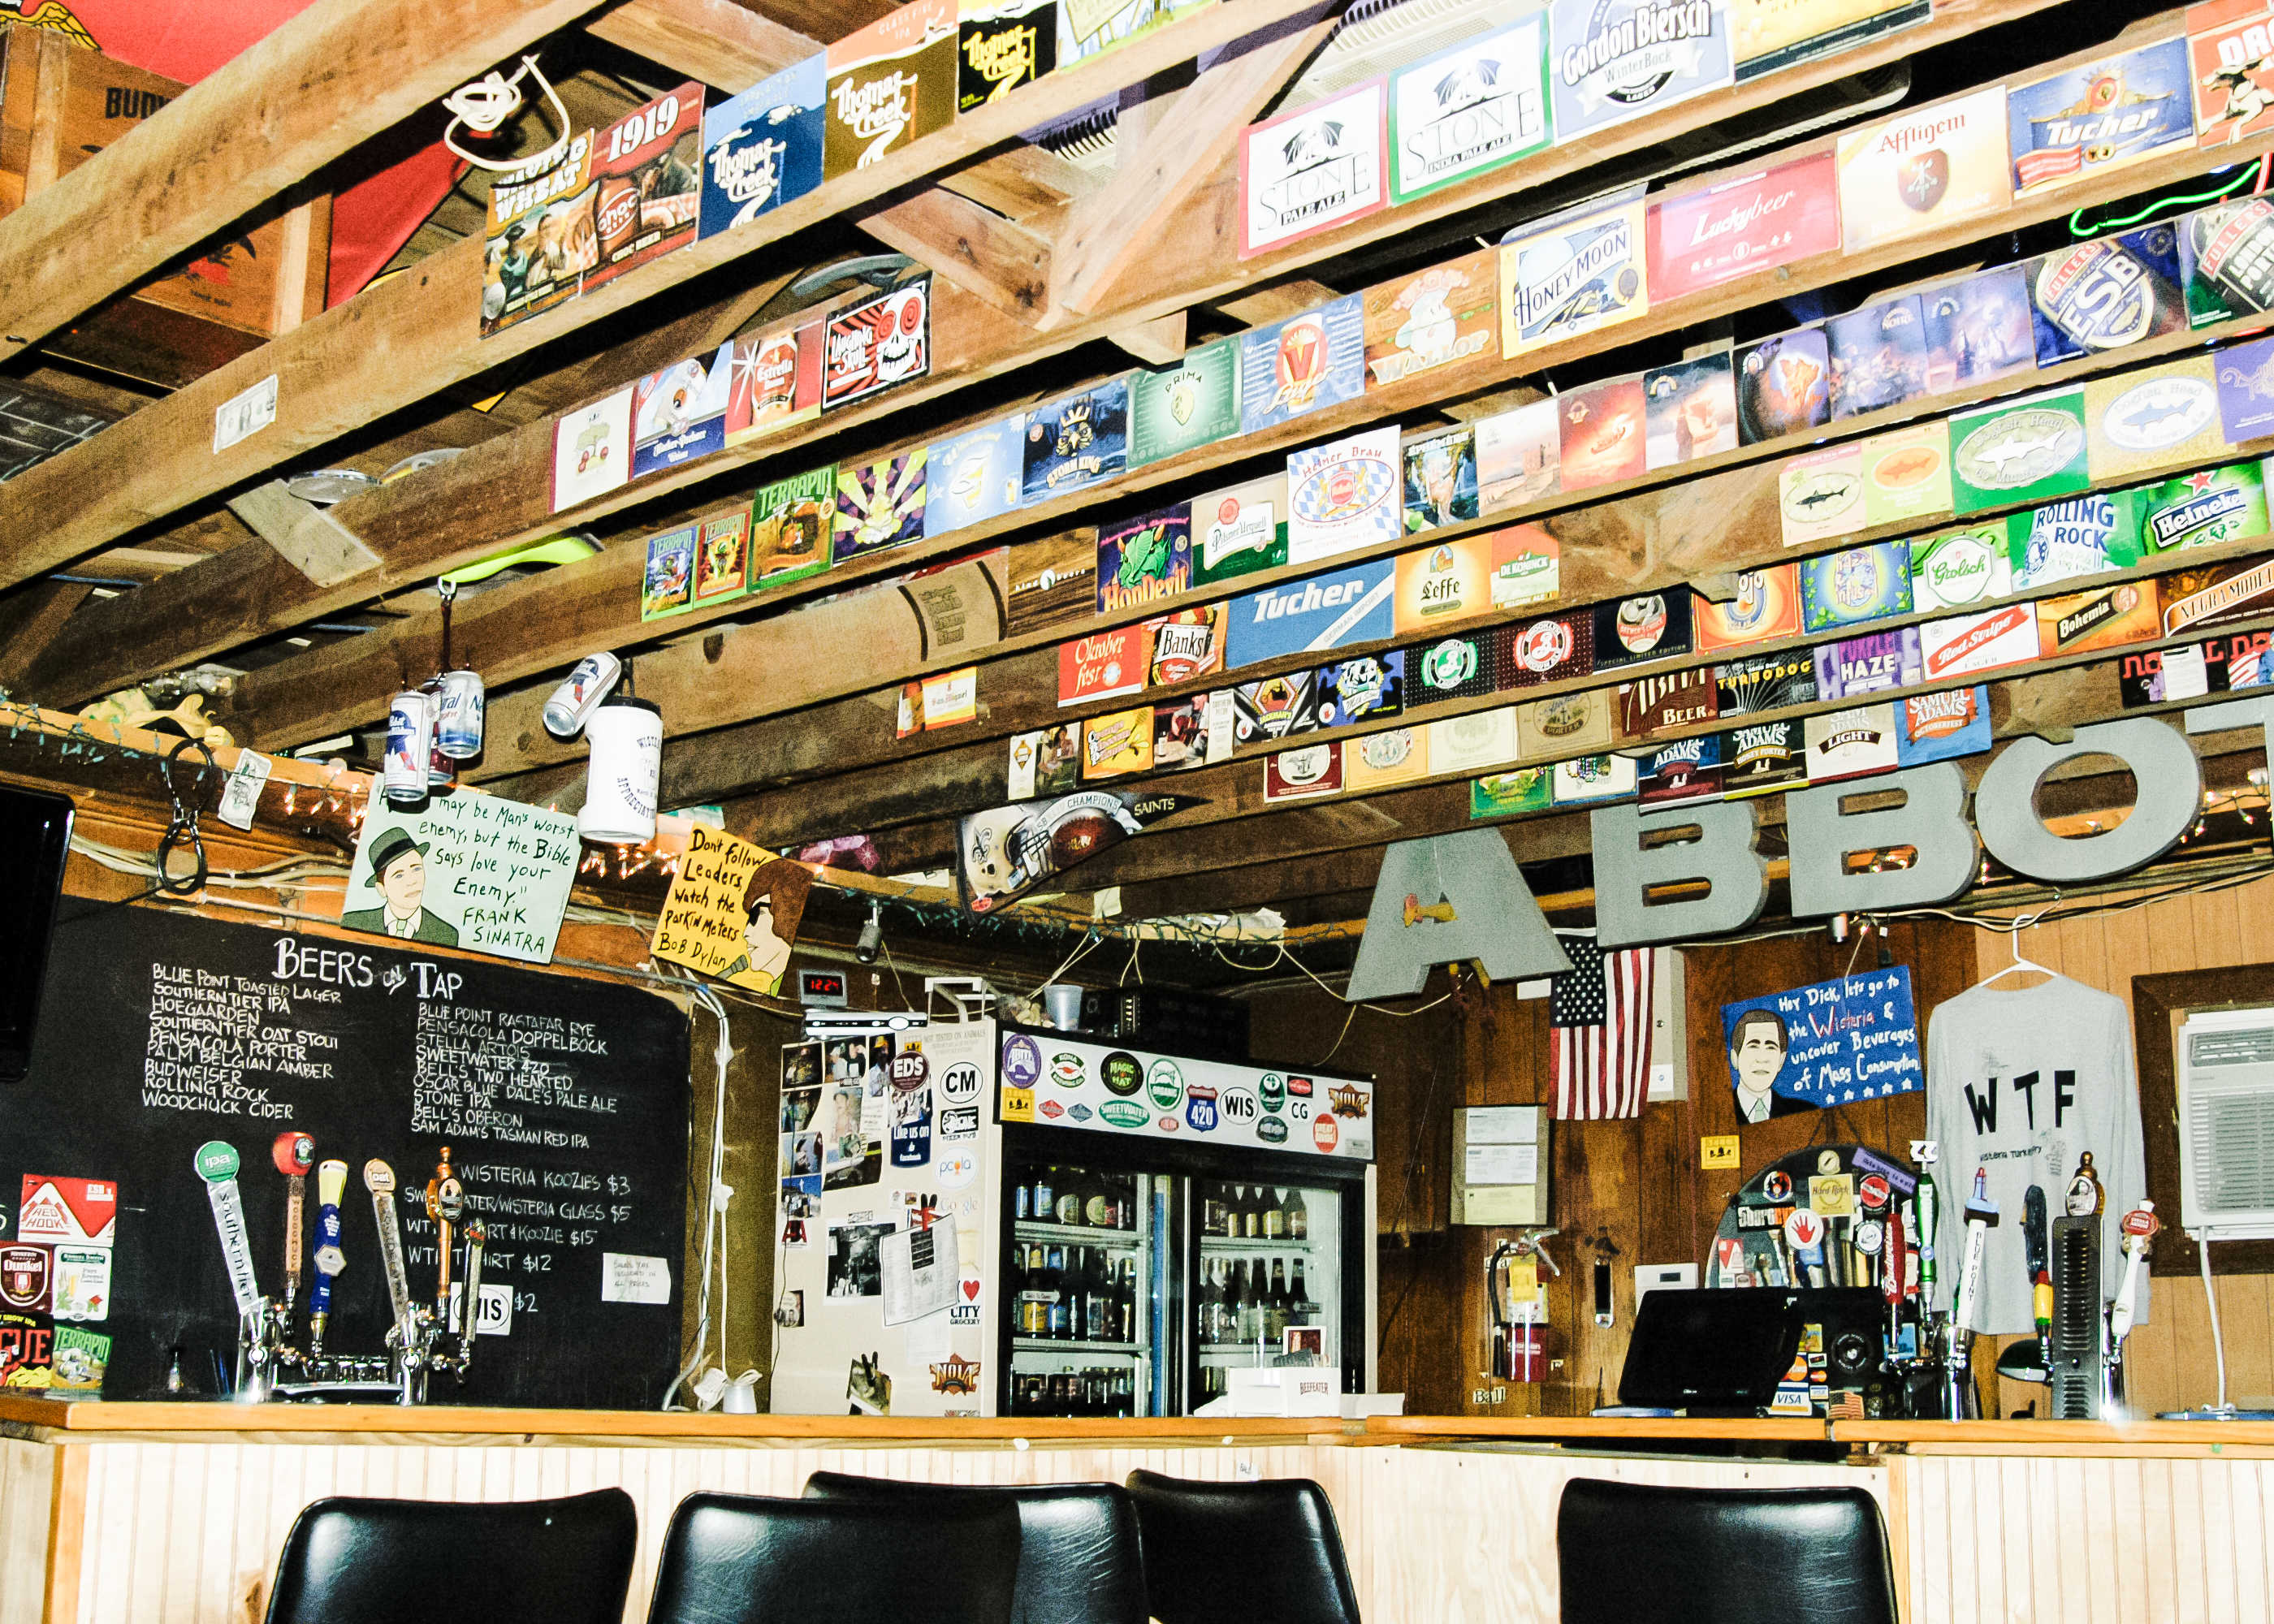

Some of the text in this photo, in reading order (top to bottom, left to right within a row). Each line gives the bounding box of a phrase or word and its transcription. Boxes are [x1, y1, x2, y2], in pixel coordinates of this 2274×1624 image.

[1561, 19, 1636, 86] Gordon
[607, 95, 680, 162] 1919
[1406, 89, 1540, 181] STONE
[1878, 113, 1965, 154] Affligem
[2046, 106, 2159, 147] Tucher
[1258, 152, 1371, 231] STONE
[1514, 266, 1574, 326] HONEY
[1576, 230, 1628, 279] MOON
[2060, 253, 2142, 339] ESB
[834, 347, 870, 374] SKULL
[1165, 370, 1203, 393] PRIMA
[759, 468, 832, 519] TERRAPIN
[2036, 499, 2114, 529] ROLLING
[2055, 526, 2108, 553] ROCK
[1932, 555, 1985, 585] Grolsch
[1252, 579, 1364, 624] Tucher
[1420, 577, 1461, 601] Leffe
[2060, 603, 2110, 638] Bohemia
[1161, 630, 1204, 659] Banks
[1719, 660, 1812, 689] TURBODOG
[1840, 654, 1896, 681] HAZE
[1663, 705, 1706, 725] BEER
[1915, 703, 1966, 728] ADAMS
[1737, 735, 1786, 756] ADAMS
[1828, 732, 1873, 749] LIGHT
[1654, 745, 1701, 768] ADAMS
[439, 797, 575, 839] may be Man's worst
[1135, 797, 1175, 816] SAINTS
[419, 821, 571, 866] enemy, but the Bible
[689, 828, 723, 853] Don't
[470, 851, 497, 873] love
[508, 864, 551, 882] your
[462, 907, 527, 926] FRANK
[716, 892, 735, 914] the
[473, 926, 546, 954] SINATRA
[690, 941, 727, 968] Dylan
[270, 937, 374, 988] BEERS
[410, 961, 463, 1000] TAP
[152, 963, 192, 984] BLUE
[234, 977, 290, 998] TOASTED
[293, 983, 342, 1004] LAGER
[153, 981, 291, 1015] SOUTHERN TIER IPA
[1805, 986, 1841, 1007] Dick,
[1844, 978, 1865, 999] lets
[1868, 981, 1883, 998] go
[1886, 974, 1900, 990] to
[151, 996, 260, 1026] HOEGAARDEN
[418, 1001, 451, 1021] BLUE
[455, 1007, 492, 1024] POINT
[569, 1021, 597, 1039] RYE
[149, 1011, 338, 1050] SOUTHERN TIER OAT STOUT
[149, 1026, 307, 1061] PENSACOLA PORTER
[417, 1017, 506, 1042] PENSACOLA
[1788, 1021, 1808, 1042] the
[147, 1040, 335, 1079] PALM BELGIAN AMBER
[415, 1031, 531, 1061] STELLA ARTOIS
[415, 1044, 550, 1075] SWEETWATER 420
[1790, 1026, 1916, 1065] uncover Beverages
[145, 1057, 243, 1086] BUDWEISER
[416, 1061, 573, 1092] BELL'S TWO HEARTED
[893, 1058, 923, 1078] EDS
[945, 1070, 976, 1094] CM
[1792, 1067, 1813, 1092] of
[1818, 1065, 1852, 1091] Mass
[145, 1072, 270, 1104] ROLLING ROCK
[413, 1073, 618, 1113] OSCAR BLUE DALE'S PALE ALE
[413, 1088, 492, 1109] STONE IPA
[1963, 1069, 2076, 1136] WTF
[141, 1088, 294, 1120] WOODCHUCK CIDER
[413, 1104, 523, 1127] BELL'S OBERON
[1191, 1106, 1213, 1125] 420
[1225, 1095, 1254, 1116] WIS
[1291, 1102, 1308, 1120] CG
[411, 1117, 590, 1149] SAM ADAM'S TASMAN RED IPA
[204, 1154, 231, 1168] ipa
[460, 1164, 631, 1196] WISTERIA KOOZIES $3
[25, 1218, 63, 1229] HOOK
[559, 1203, 633, 1224] GLASS $5
[518, 1227, 564, 1245] KOOZIE
[570, 1229, 598, 1246] $15
[523, 1254, 553, 1273] $12
[514, 1292, 538, 1312] $2
[1475, 1388, 1504, 1403] Ball
[1777, 1393, 1802, 1404] VISA
